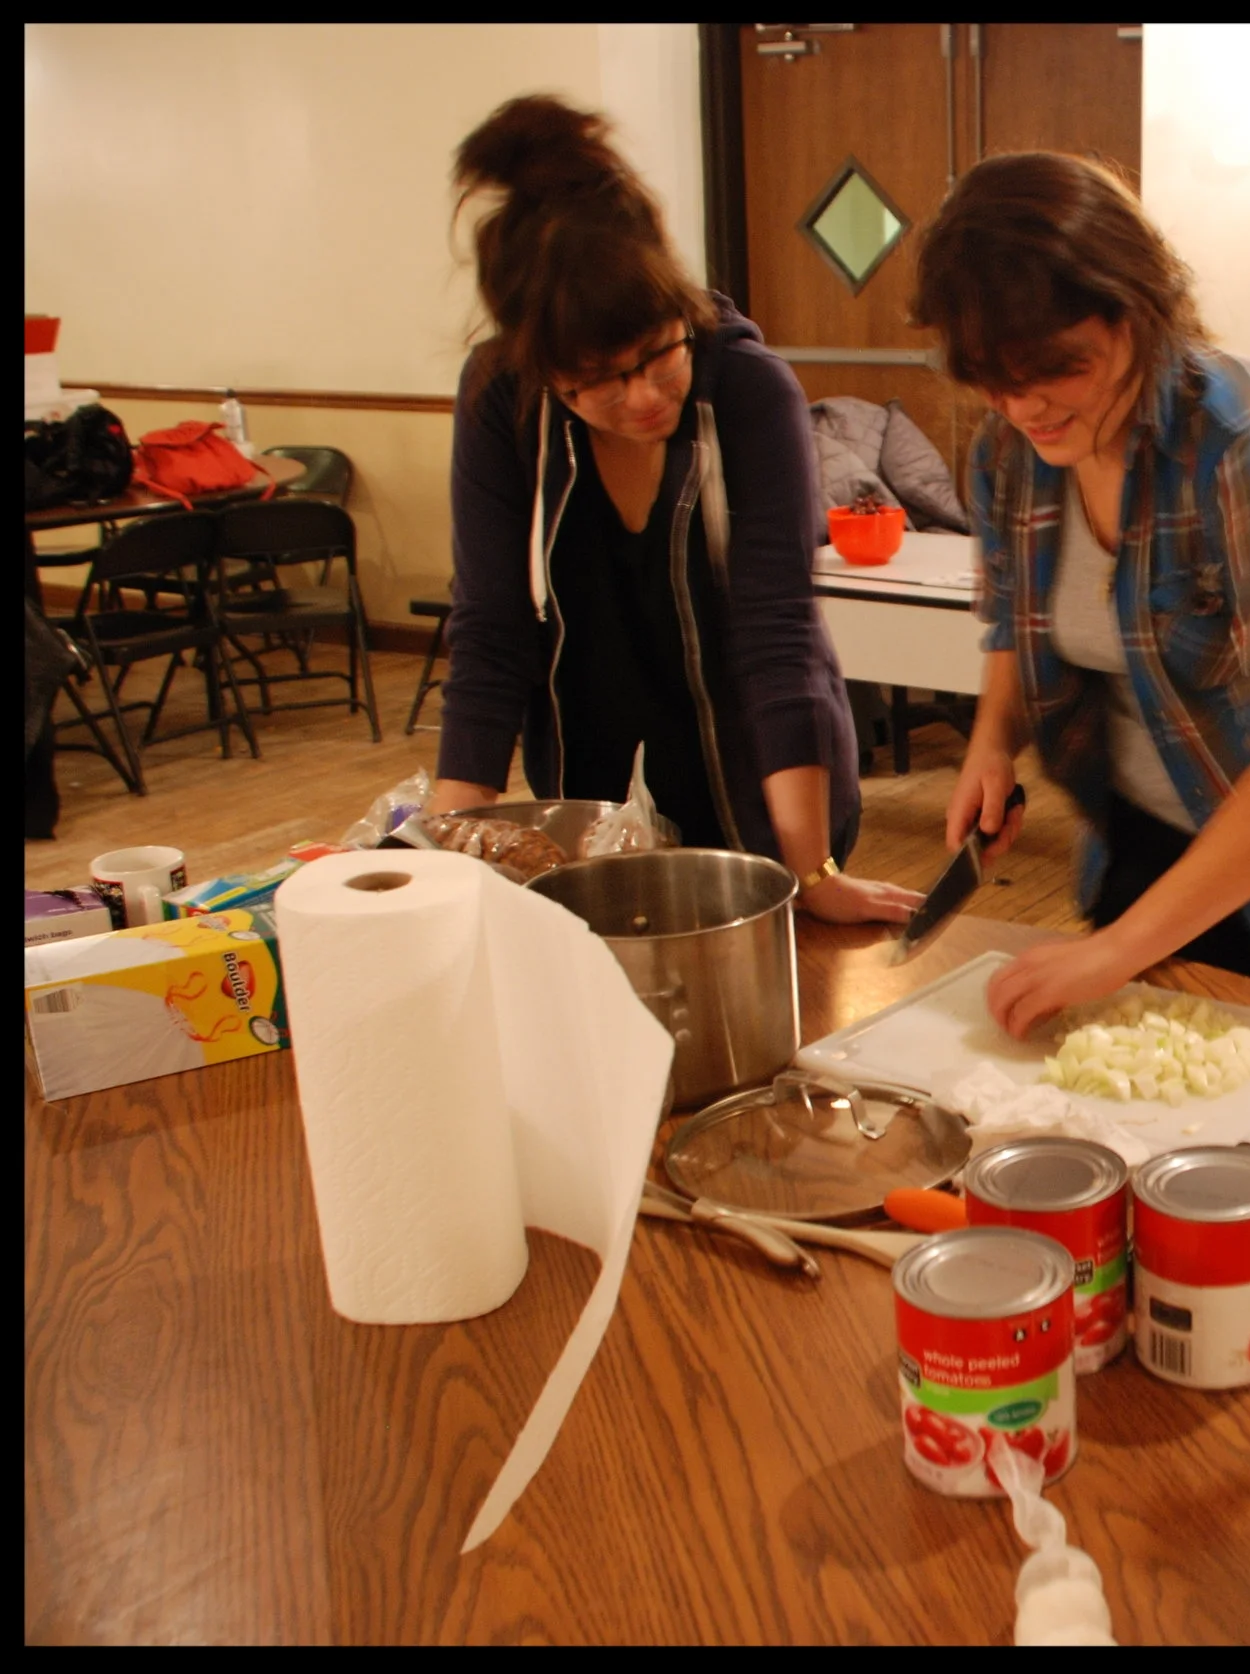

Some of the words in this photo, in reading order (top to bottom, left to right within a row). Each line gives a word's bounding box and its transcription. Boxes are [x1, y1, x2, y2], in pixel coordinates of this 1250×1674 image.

[223, 951, 251, 1012] Boulder
[922, 1349, 964, 1369] whole
[968, 1351, 1021, 1372] peeled
[923, 1364, 993, 1388] tomatoes
